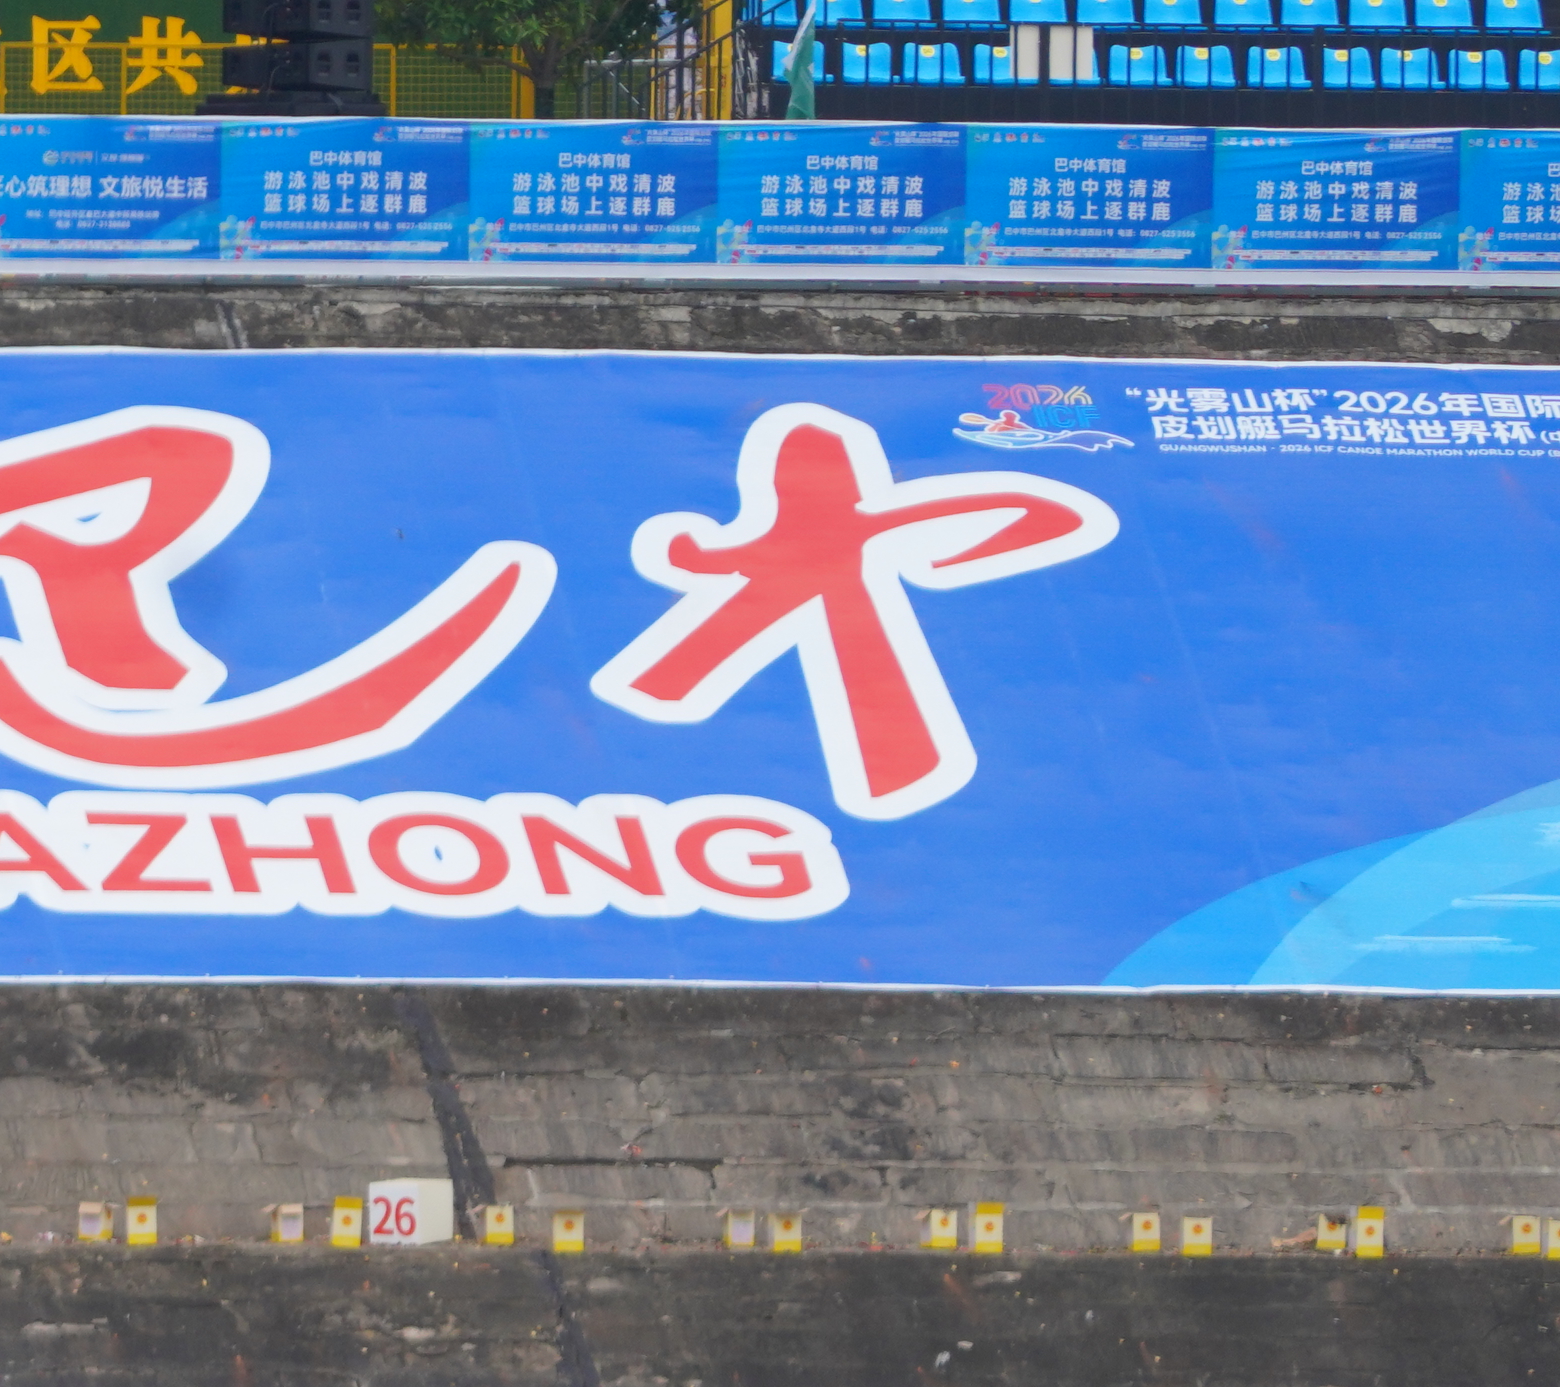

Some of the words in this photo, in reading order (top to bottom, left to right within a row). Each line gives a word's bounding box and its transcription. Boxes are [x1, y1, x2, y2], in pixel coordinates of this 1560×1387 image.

[1337, 446, 1384, 455] CANOE
[1388, 448, 1463, 457] MARATHON
[1465, 449, 1515, 457] WORLD
[1517, 450, 1545, 458] CUP
[372, 1197, 417, 1237] 26
